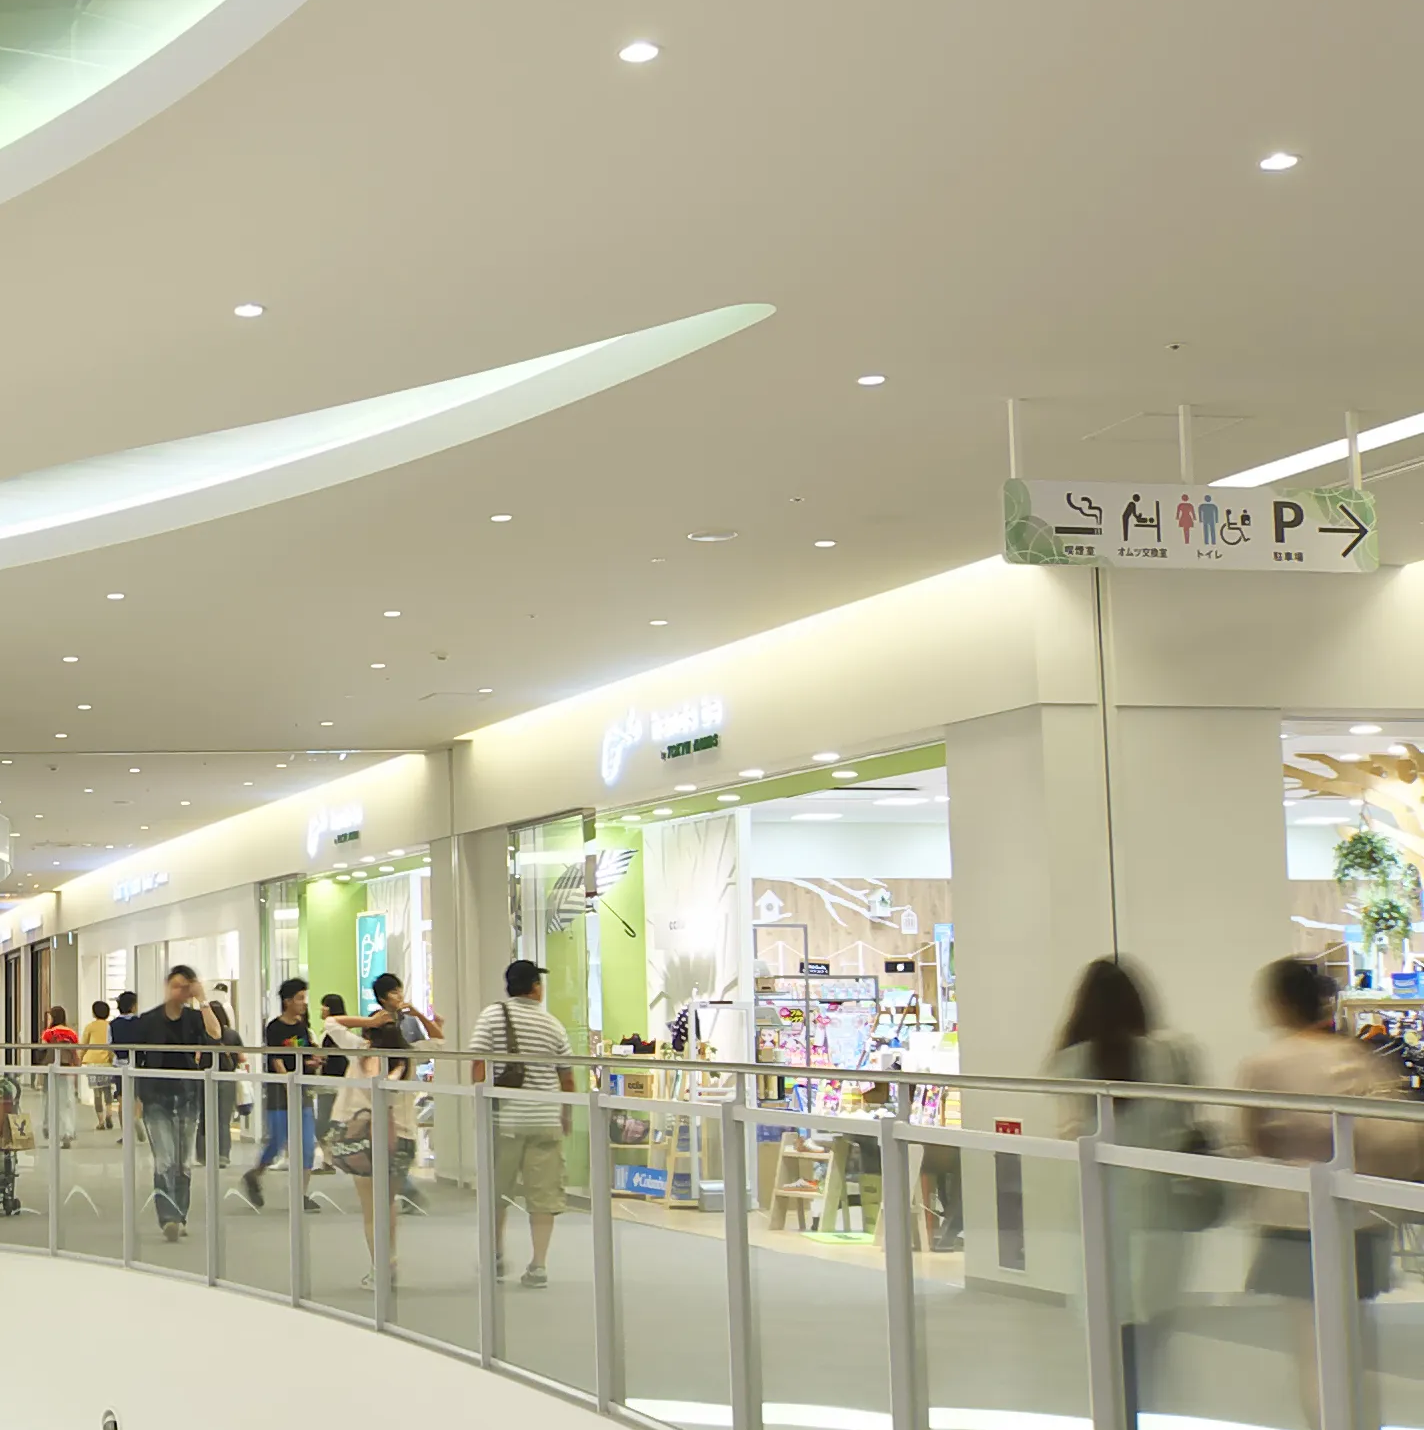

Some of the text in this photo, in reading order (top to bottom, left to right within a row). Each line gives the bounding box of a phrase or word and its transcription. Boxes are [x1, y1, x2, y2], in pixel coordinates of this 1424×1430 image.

[1273, 501, 1304, 543] P
[1064, 545, 1095, 556] 喫煙室
[1117, 547, 1168, 558] オムツ交換室
[1196, 549, 1223, 560] トイレ
